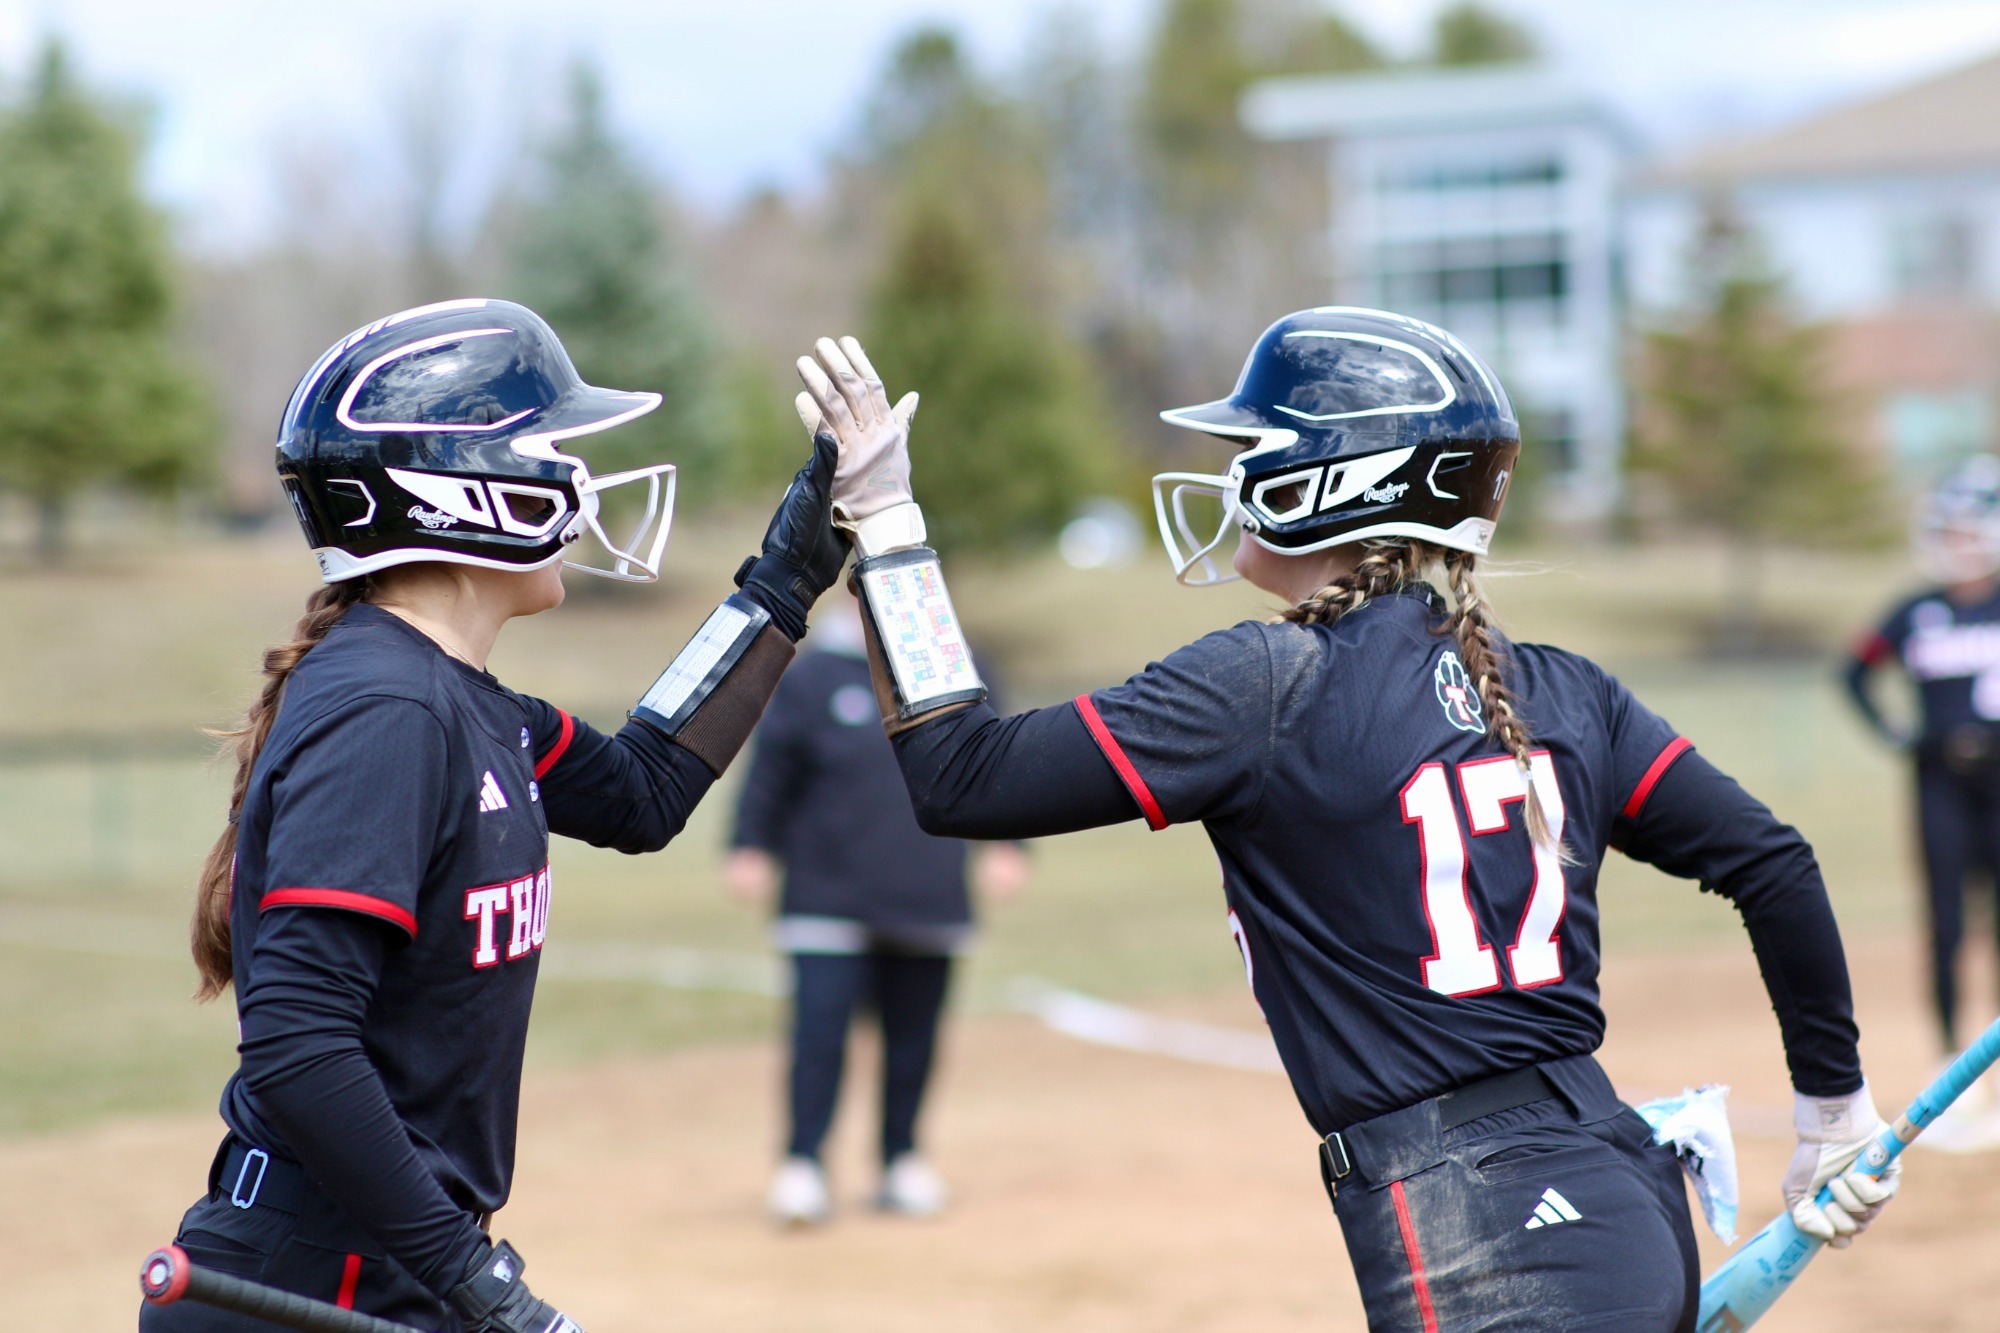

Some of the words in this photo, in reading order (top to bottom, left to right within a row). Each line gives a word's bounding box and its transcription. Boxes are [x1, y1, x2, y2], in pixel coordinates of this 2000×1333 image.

[1363, 481, 1409, 502] Rawlings
[1493, 469, 1509, 501] 17
[407, 505, 459, 528] Rawlings
[1444, 684, 1473, 723] T
[1399, 749, 1566, 998] 17
[463, 859, 551, 969] THO
